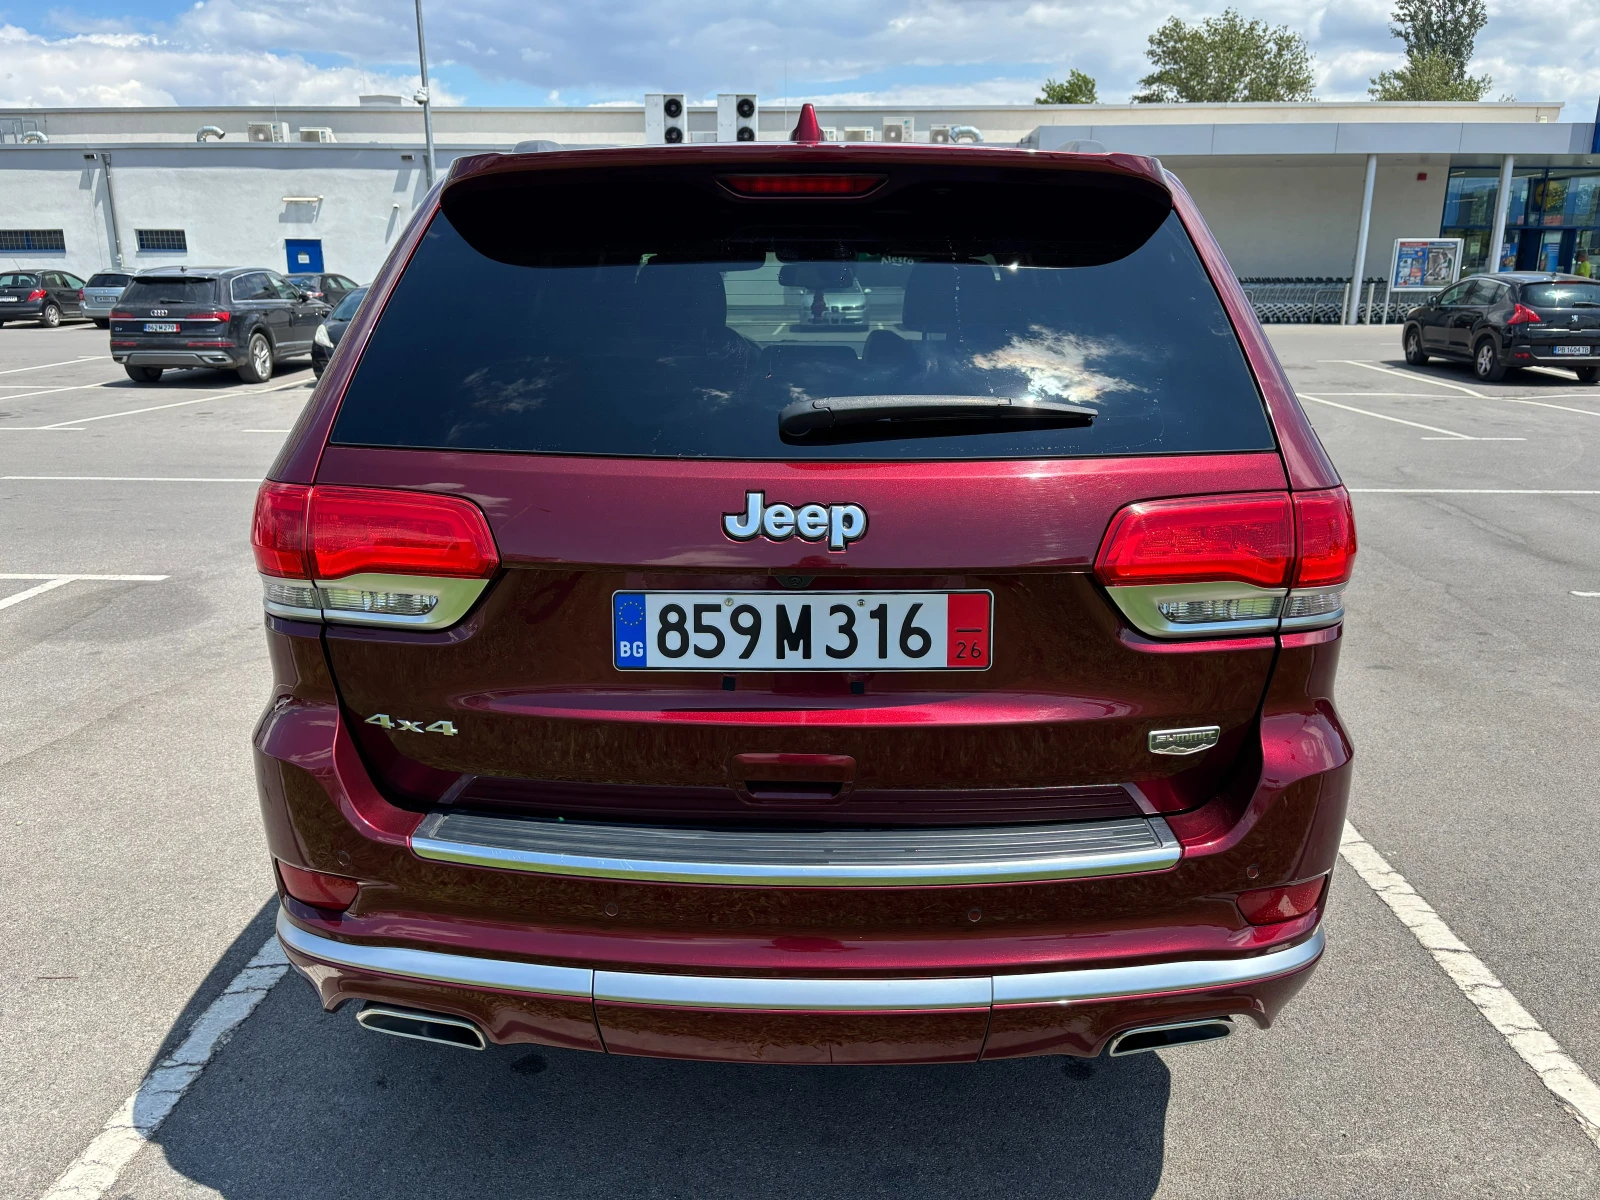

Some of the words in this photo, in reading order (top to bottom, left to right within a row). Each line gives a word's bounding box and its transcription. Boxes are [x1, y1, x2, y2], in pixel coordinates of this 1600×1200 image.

[880, 255, 914, 265] Alesto
[722, 490, 868, 551] Jeep
[657, 603, 762, 660] 859
[775, 604, 812, 660] M
[825, 603, 932, 660] 316
[620, 641, 644, 658] BG
[956, 641, 982, 659] 26
[364, 713, 458, 736] 4x4
